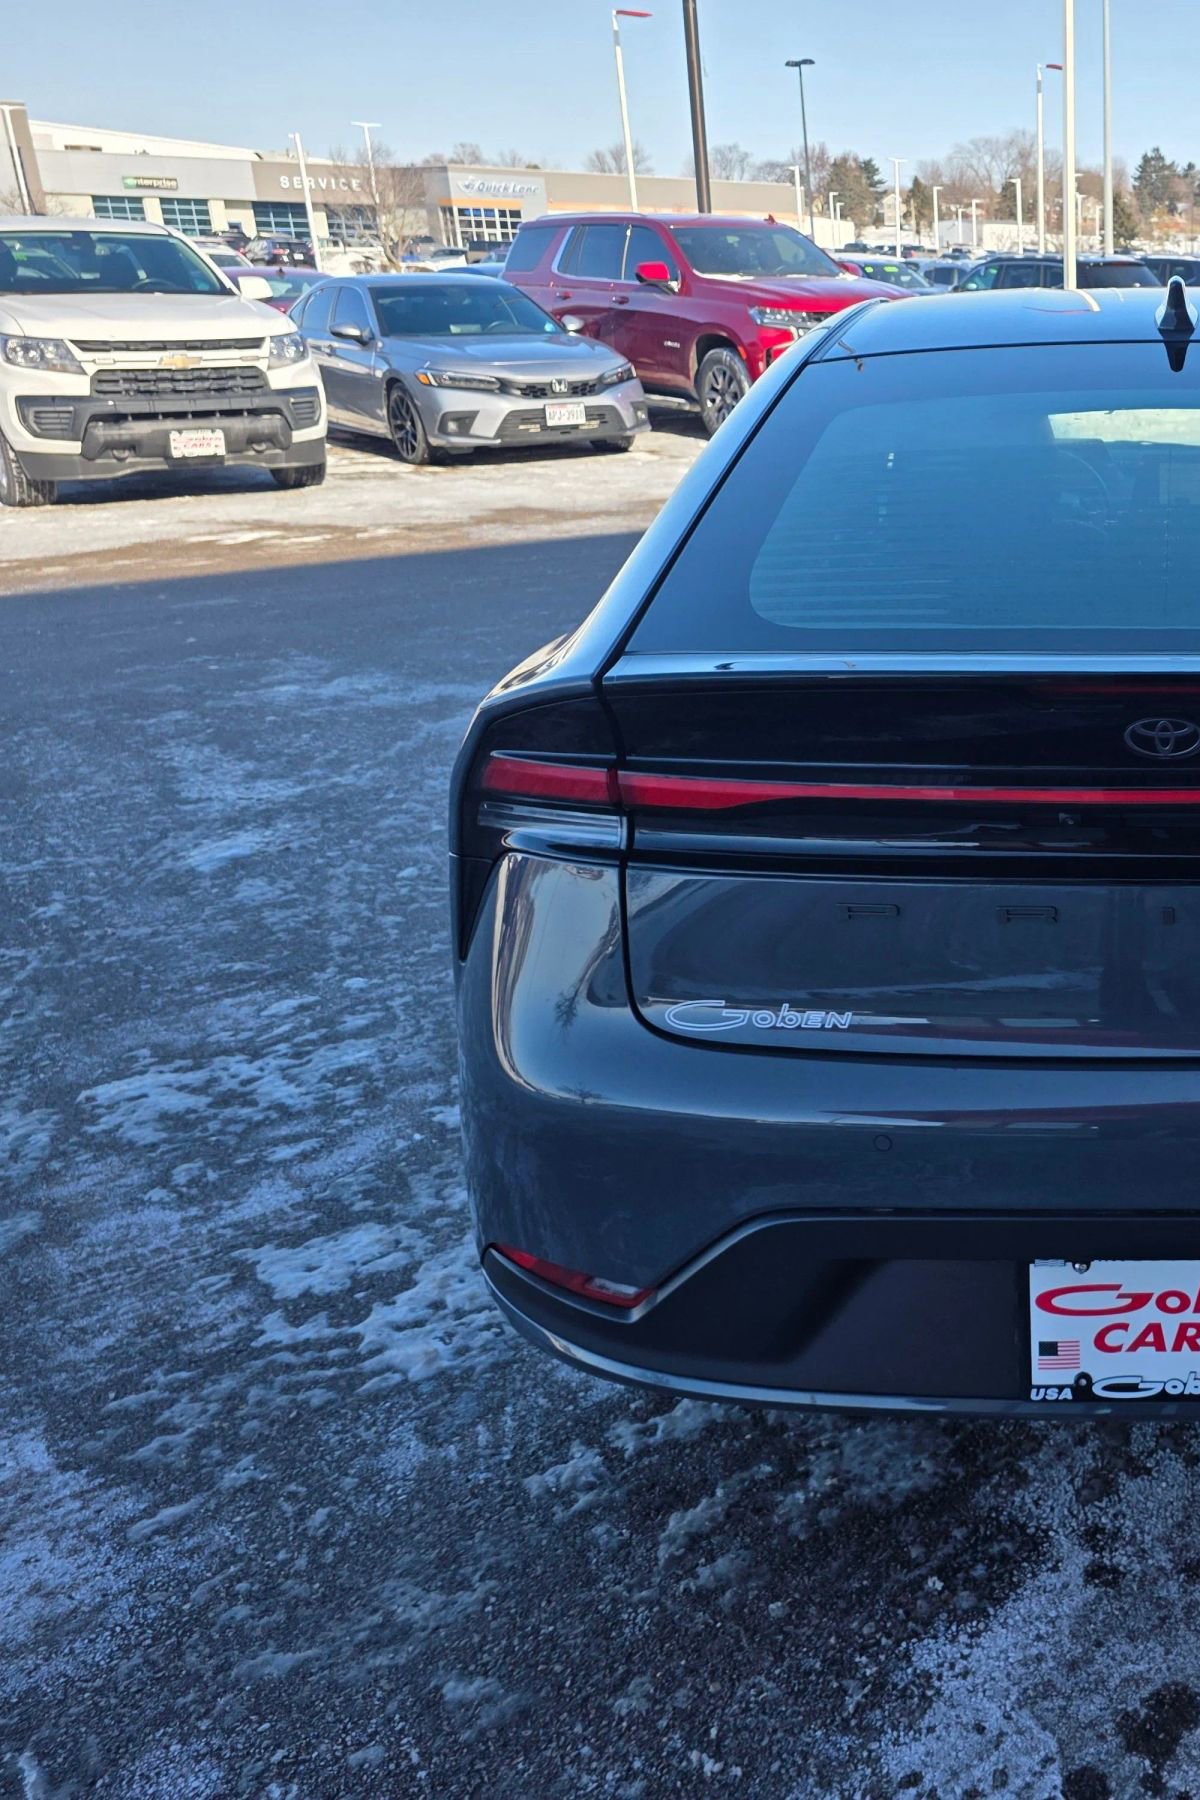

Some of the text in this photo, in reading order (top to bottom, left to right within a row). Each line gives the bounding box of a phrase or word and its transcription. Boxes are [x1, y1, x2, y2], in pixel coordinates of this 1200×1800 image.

[280, 176, 361, 191] SERVICE
[478, 181, 509, 193] Quick
[1030, 1388, 1073, 1400] USA
